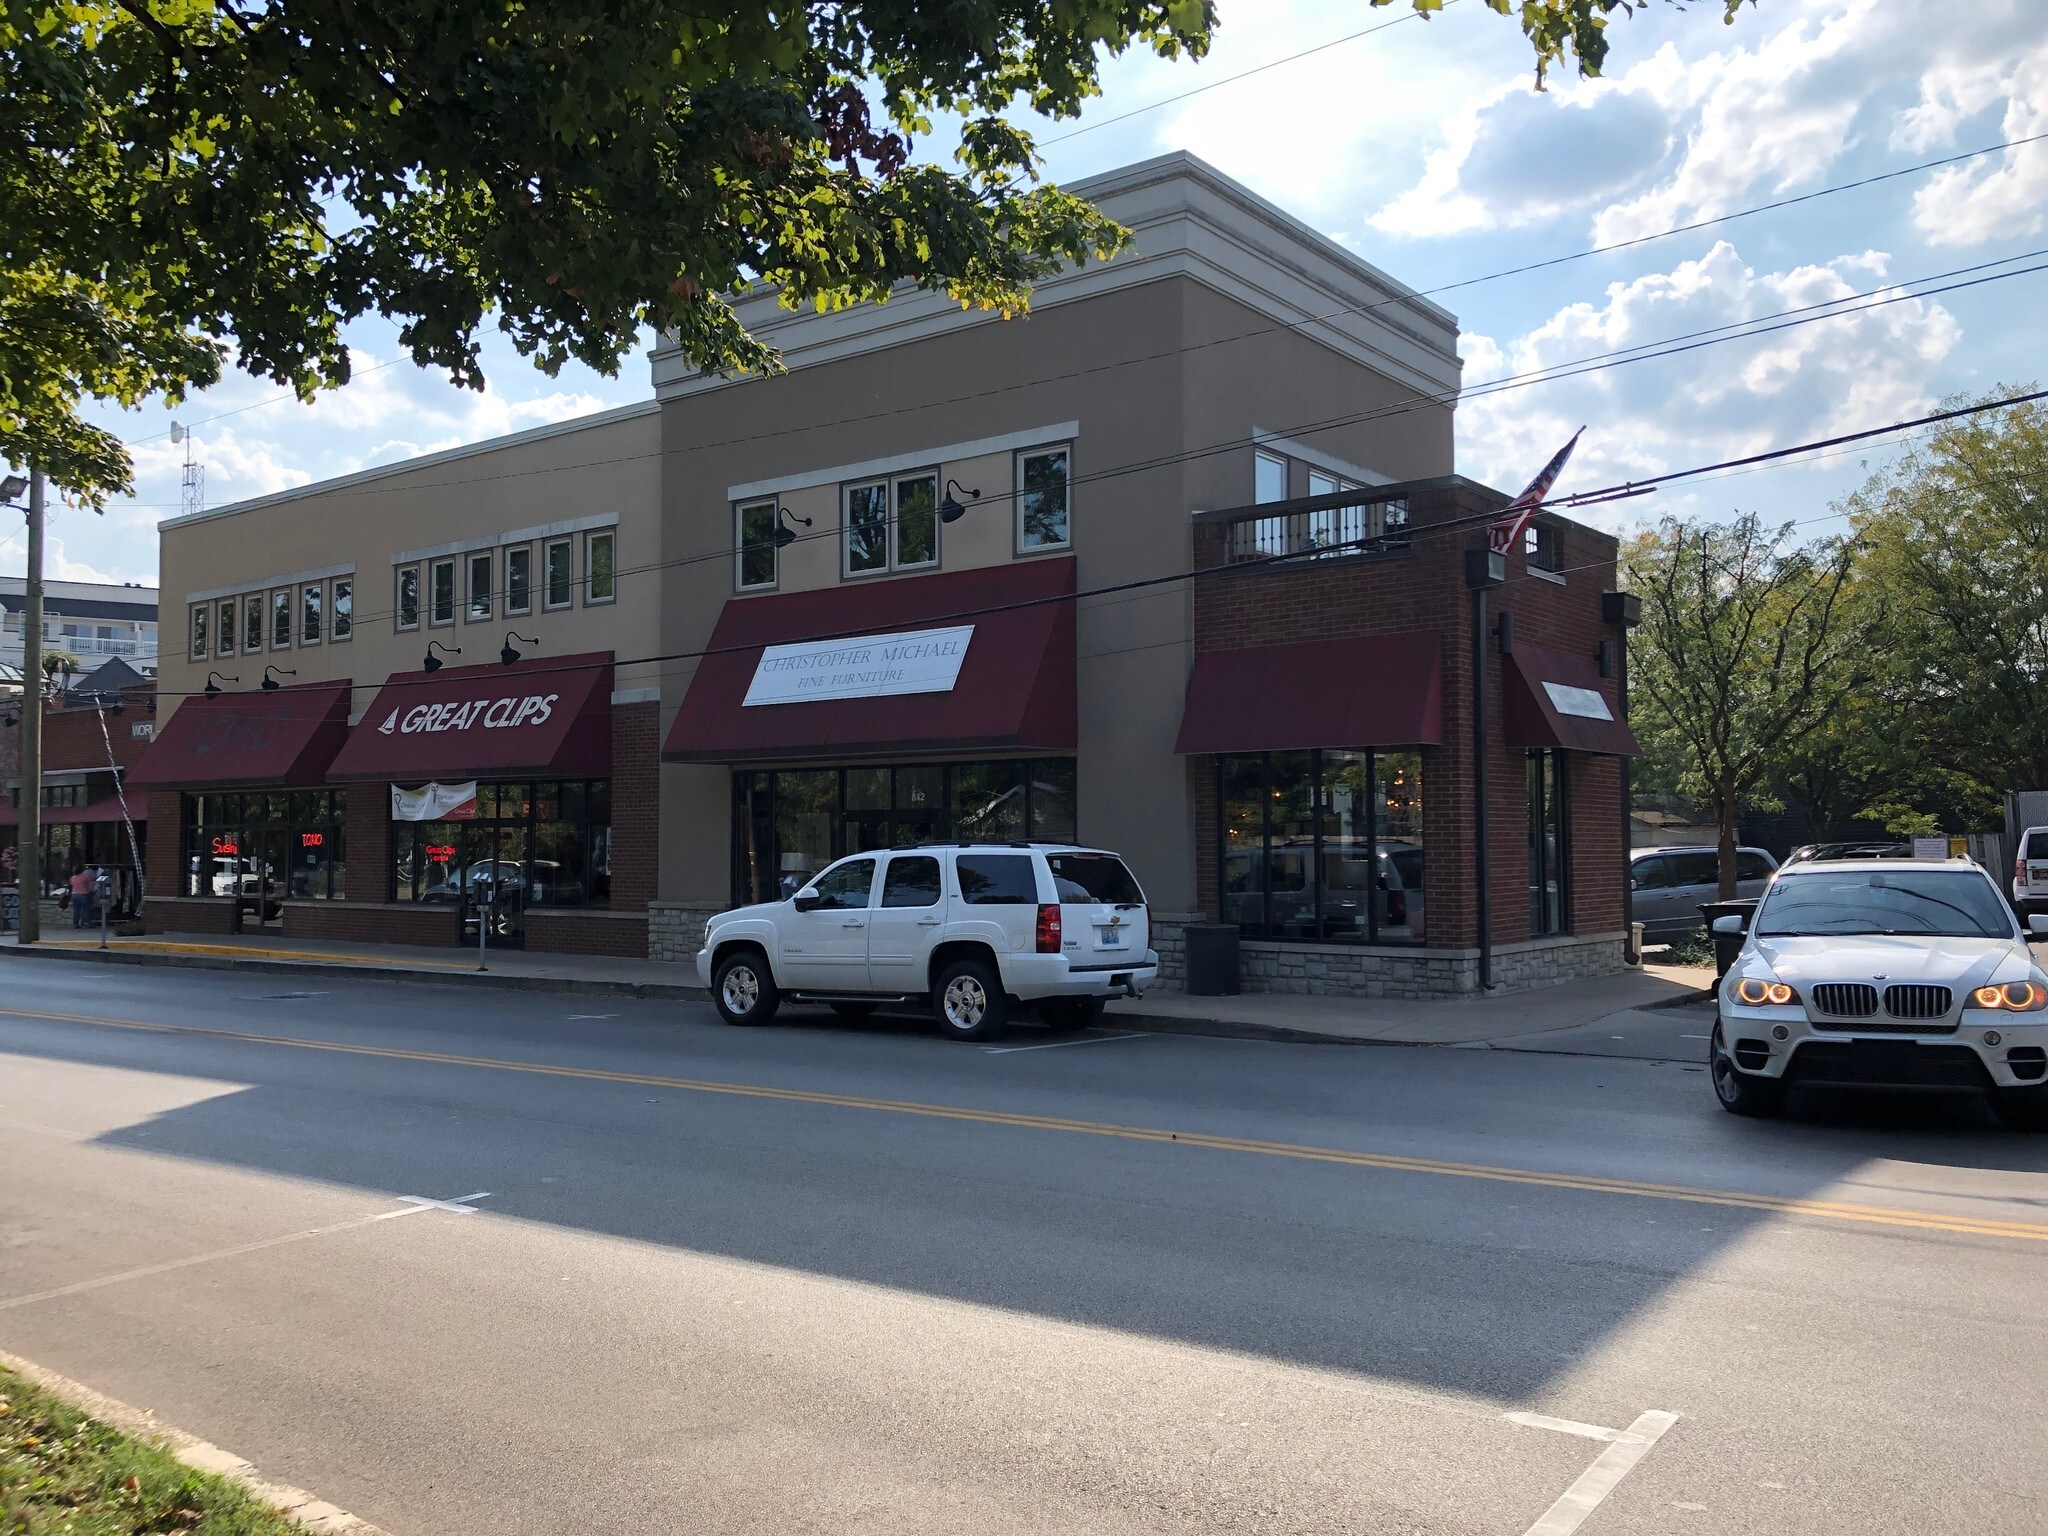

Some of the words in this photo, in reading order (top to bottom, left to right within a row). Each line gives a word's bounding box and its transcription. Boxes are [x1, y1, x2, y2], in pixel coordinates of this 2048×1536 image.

[763, 649, 871, 673] CHRISTOPHER
[880, 641, 960, 662] MICHAEL
[797, 675, 827, 689] FINE
[831, 669, 905, 686] FURNITURE
[400, 699, 490, 734] GREAT
[483, 693, 559, 729] CLIPS
